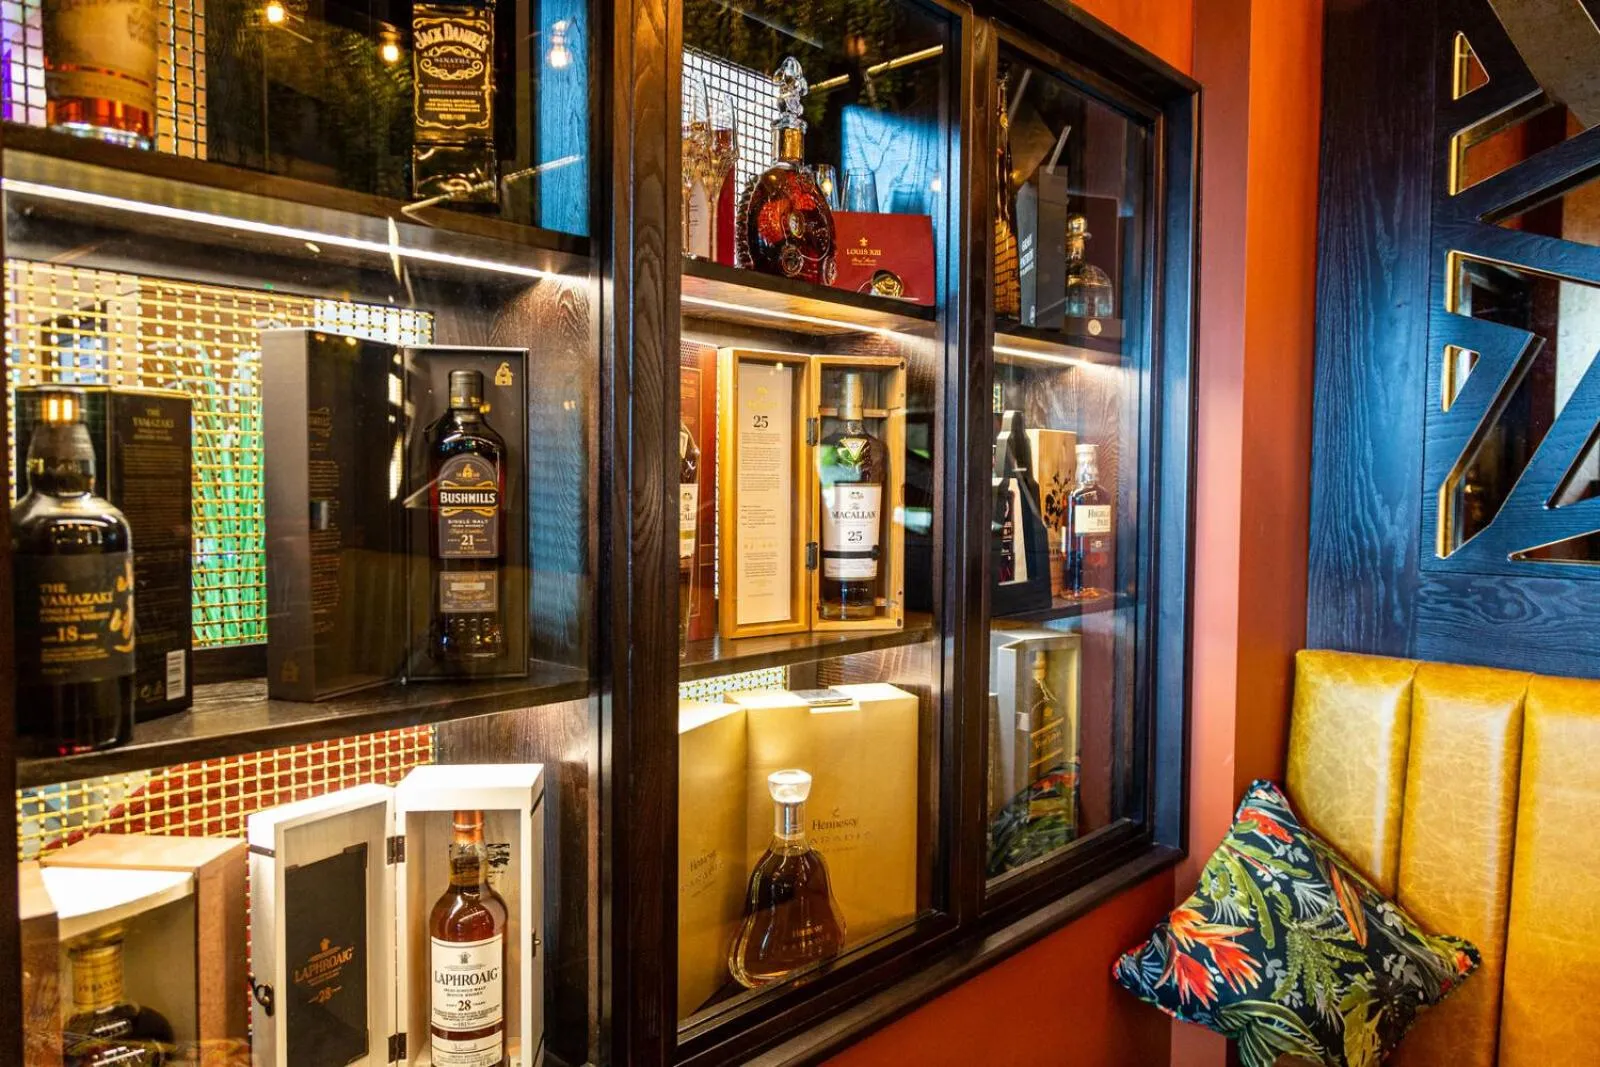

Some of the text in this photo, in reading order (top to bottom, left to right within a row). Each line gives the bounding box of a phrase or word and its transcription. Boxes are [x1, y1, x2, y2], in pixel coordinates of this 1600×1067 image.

[413, 23, 489, 52] JACK DANIEL'S
[753, 414, 769, 429] 25
[441, 491, 496, 504] BUSHMILLS
[832, 510, 877, 520] MACALLAN
[461, 534, 474, 546] 21
[847, 531, 863, 542] 25
[40, 583, 66, 593] THE
[40, 591, 113, 606] YAMAZAKI
[58, 625, 78, 641] 18
[812, 817, 858, 831] Hennessy
[295, 945, 354, 983] LAPHROAIG
[434, 968, 498, 987] LAPHROAIG
[458, 1000, 472, 1012] 28
